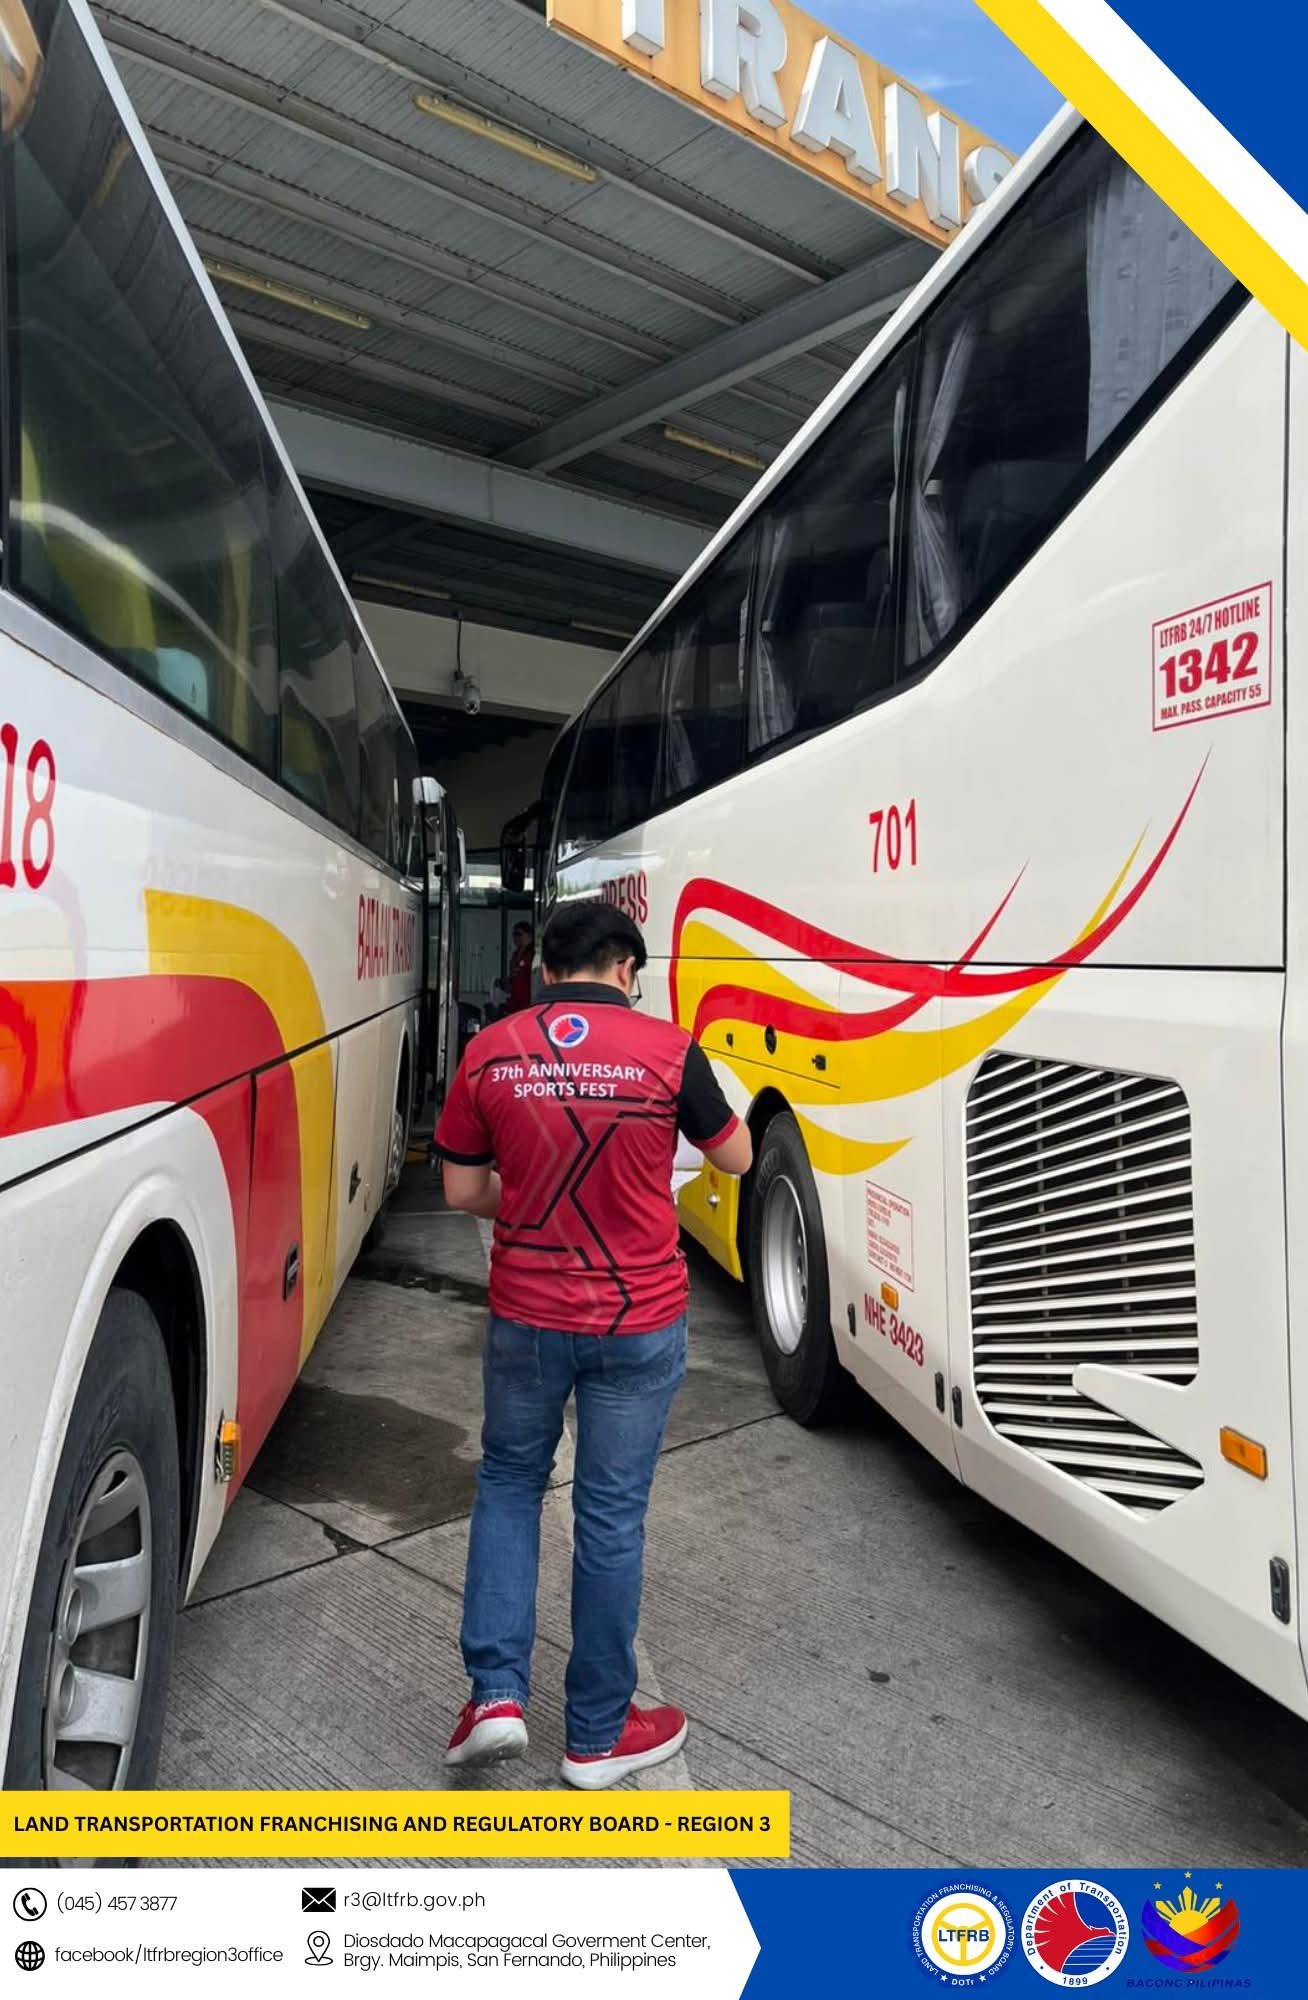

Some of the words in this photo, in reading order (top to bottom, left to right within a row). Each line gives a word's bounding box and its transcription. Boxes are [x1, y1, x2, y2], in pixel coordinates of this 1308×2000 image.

[1160, 622, 1188, 649] LTFRB
[1189, 612, 1213, 639] 24/7
[1214, 596, 1261, 630] HOTLINE
[1159, 631, 1259, 699] 1342
[1204, 687, 1248, 709] CAPACITY
[1249, 683, 1262, 699] 55
[0, 722, 56, 890] 18
[869, 798, 917, 873] 701
[491, 1064, 523, 1082] 37th
[527, 1063, 645, 1082] ANNIVERSARY
[514, 1082, 575, 1098] SPORTS
[580, 1082, 618, 1098] FEST
[864, 1292, 886, 1337] NHE
[889, 1313, 924, 1367] 3423
